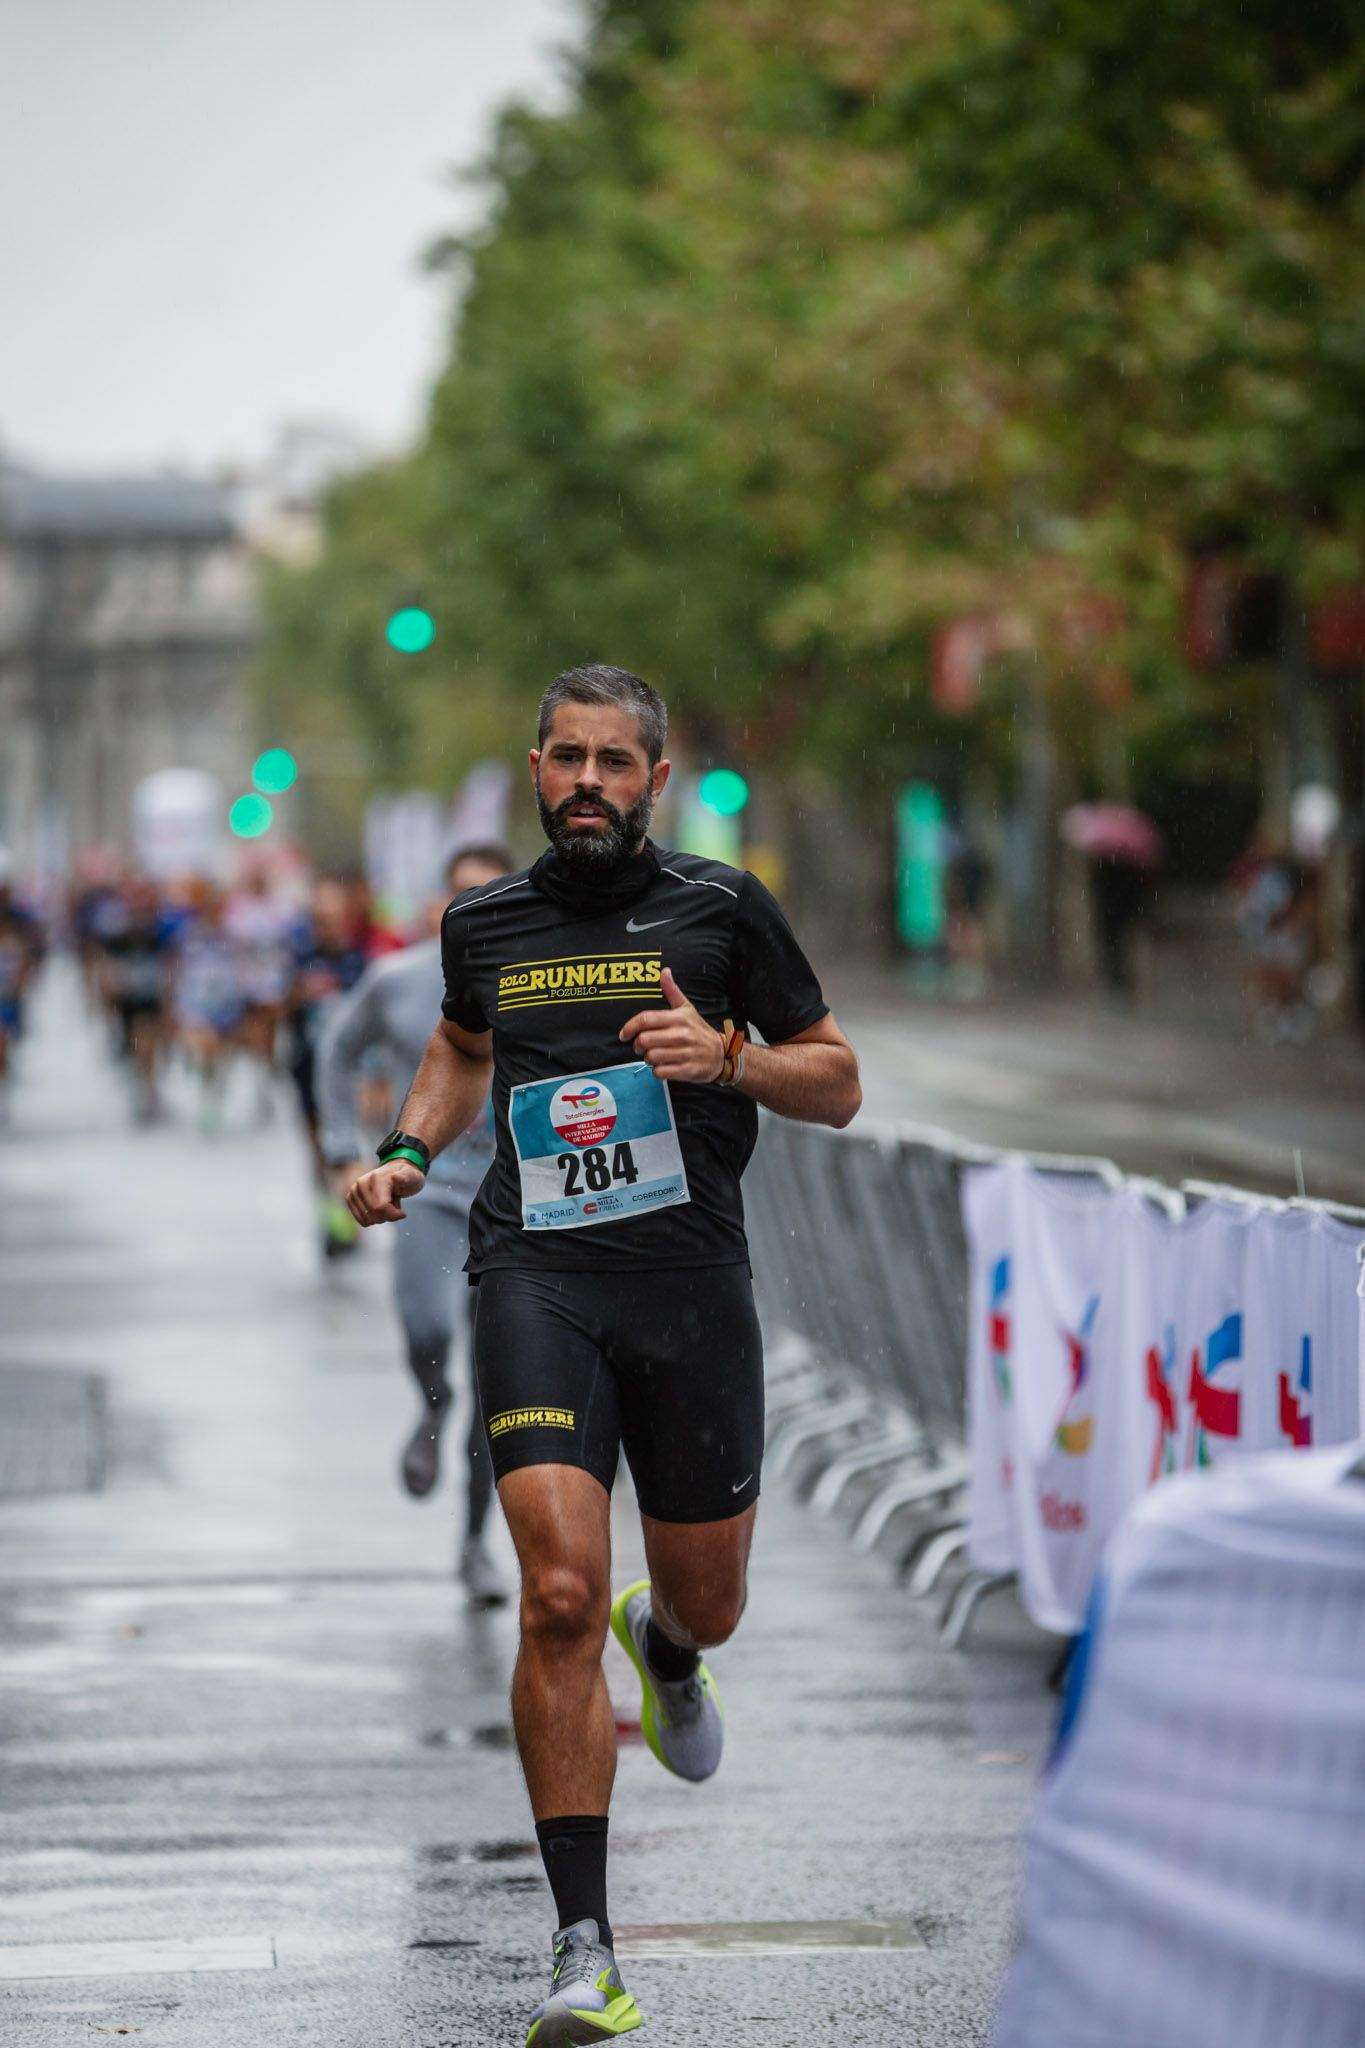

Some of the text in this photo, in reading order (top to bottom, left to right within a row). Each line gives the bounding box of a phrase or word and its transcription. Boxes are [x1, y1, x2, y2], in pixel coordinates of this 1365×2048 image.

[499, 973, 529, 989] SOLO
[550, 986, 597, 997] POZUELO
[564, 1108, 605, 1120] TotalEnergies
[564, 1125, 611, 1138] INTERNACIONAL
[576, 1121, 596, 1130] MILLA
[581, 1132, 605, 1141] MADRID
[557, 1142, 639, 1197] 284
[541, 1208, 575, 1220] MADRID
